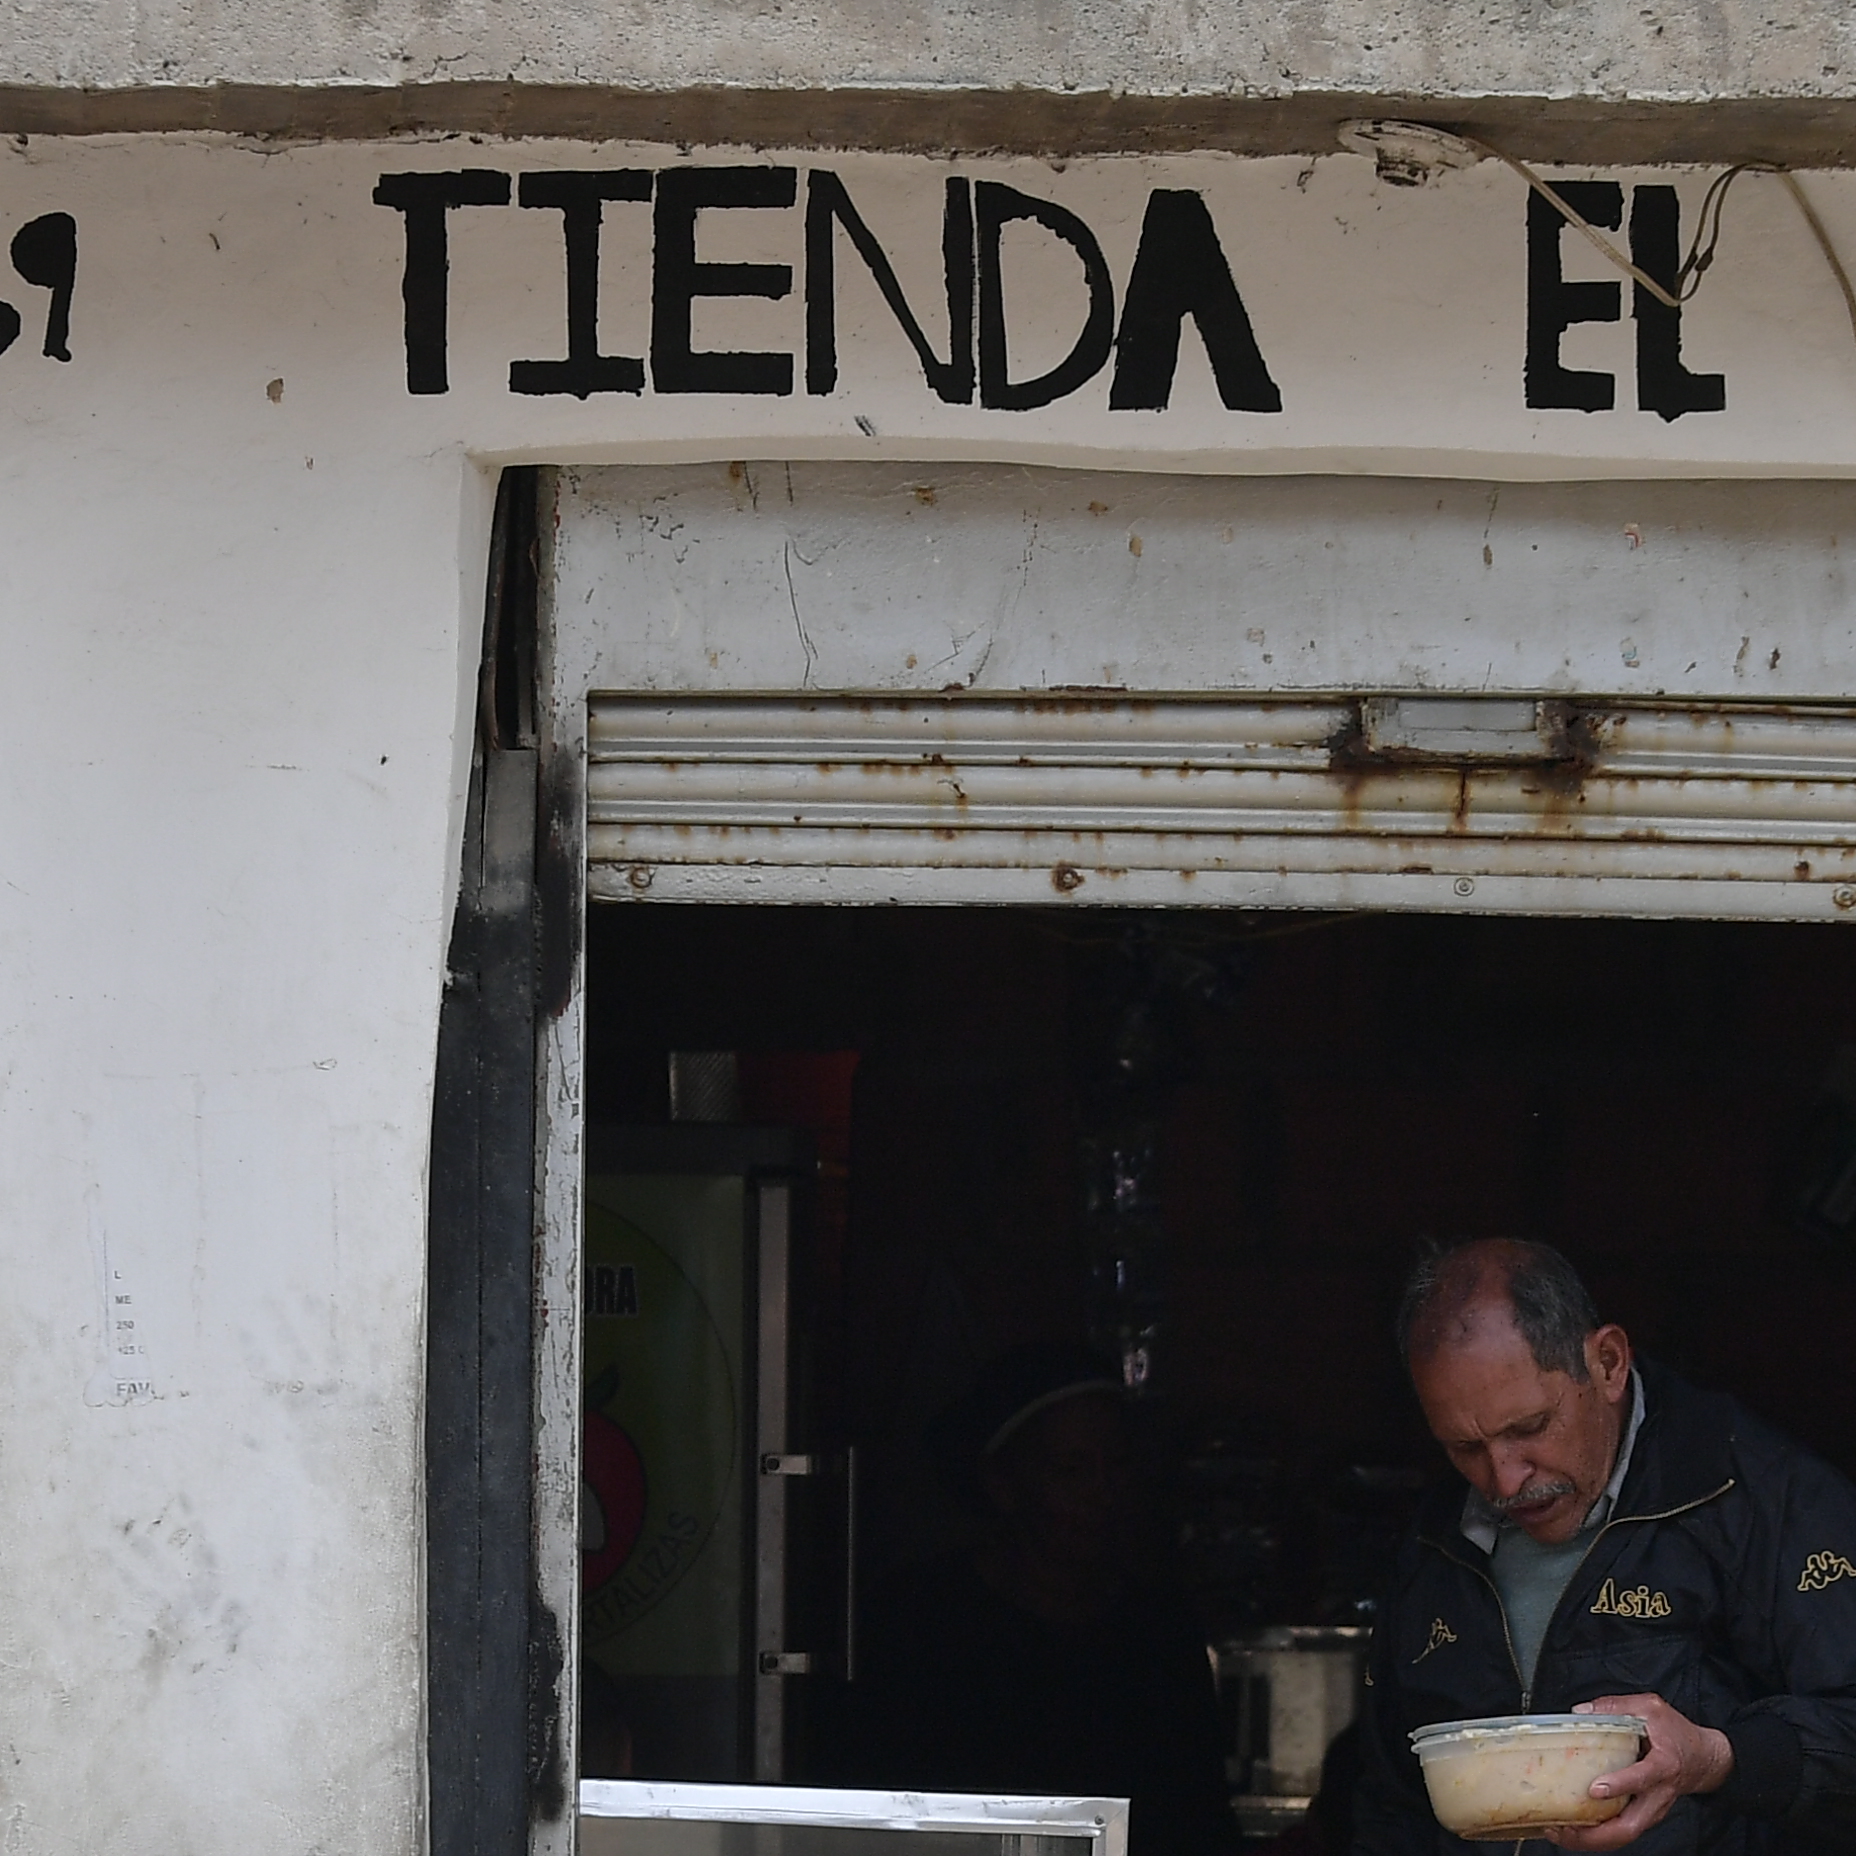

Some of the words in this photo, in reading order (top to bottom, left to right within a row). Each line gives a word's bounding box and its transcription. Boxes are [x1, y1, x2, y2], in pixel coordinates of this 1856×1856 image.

[372, 165, 1283, 413] TIENDA
[1524, 180, 1727, 421] EL
[1589, 1577, 1672, 1619] Asia
